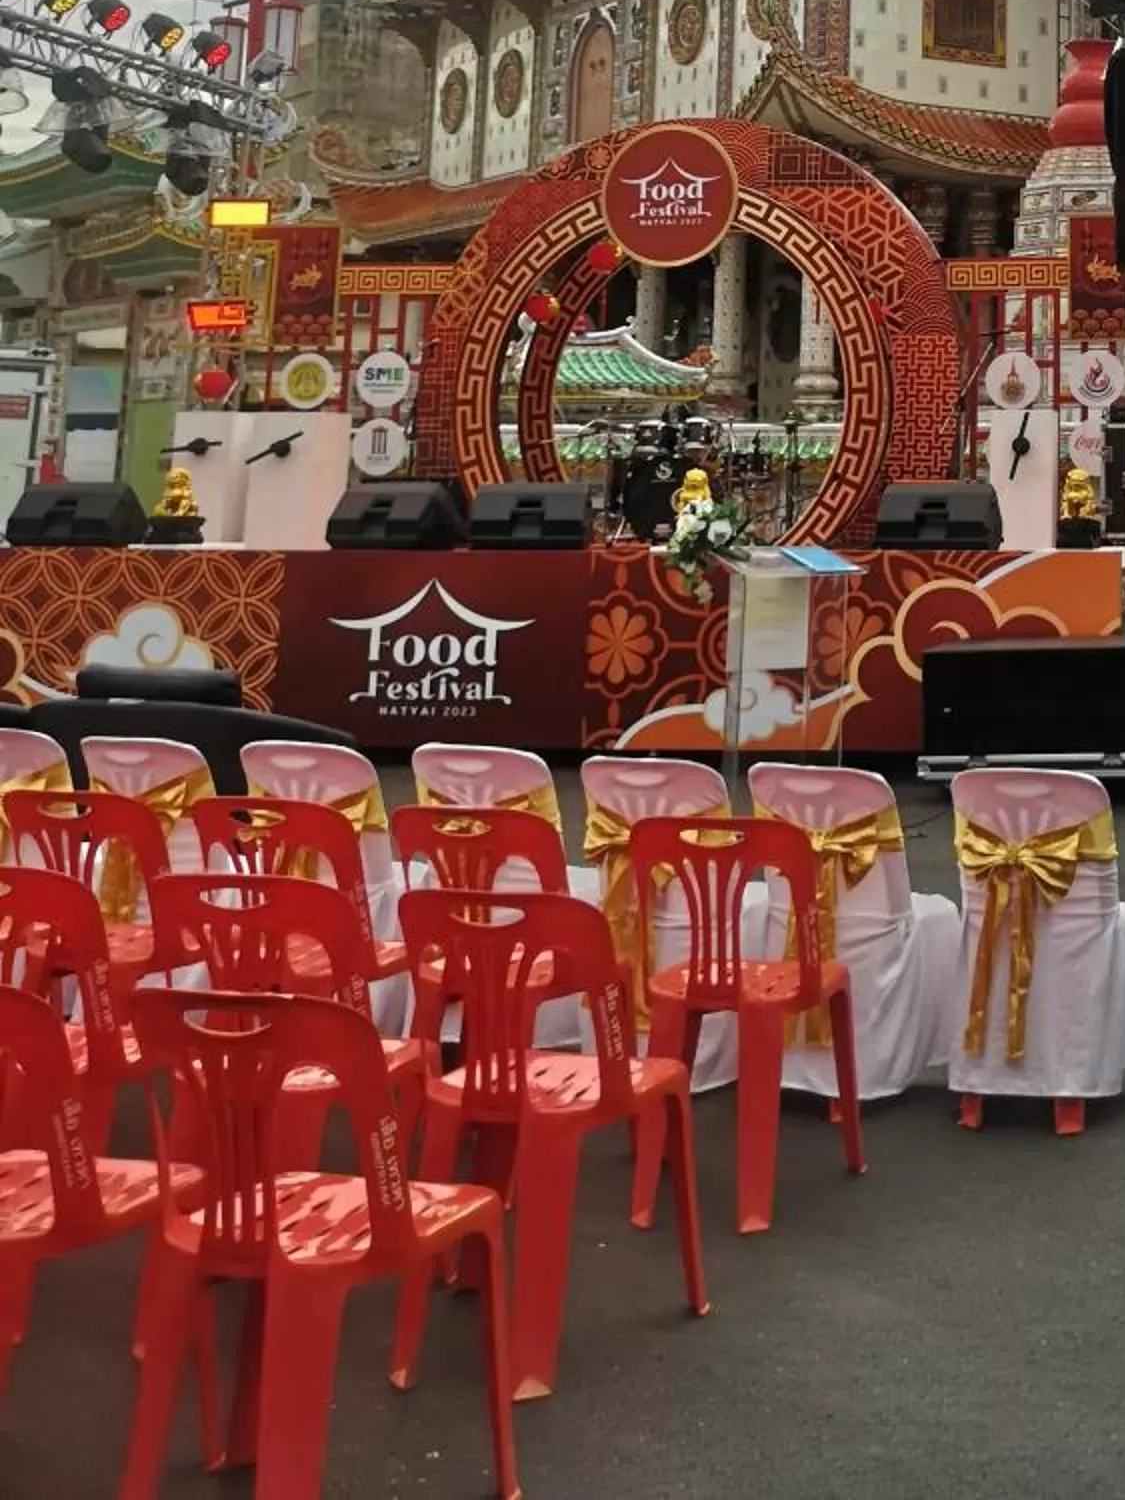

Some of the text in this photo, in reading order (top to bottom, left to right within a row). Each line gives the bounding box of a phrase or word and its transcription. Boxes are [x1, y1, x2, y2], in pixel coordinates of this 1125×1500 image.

[639, 180, 703, 200] Food
[629, 199, 712, 218] Festival
[368, 625, 498, 667] Food
[349, 668, 512, 704] Festival
[378, 706, 436, 716] HATYAI
